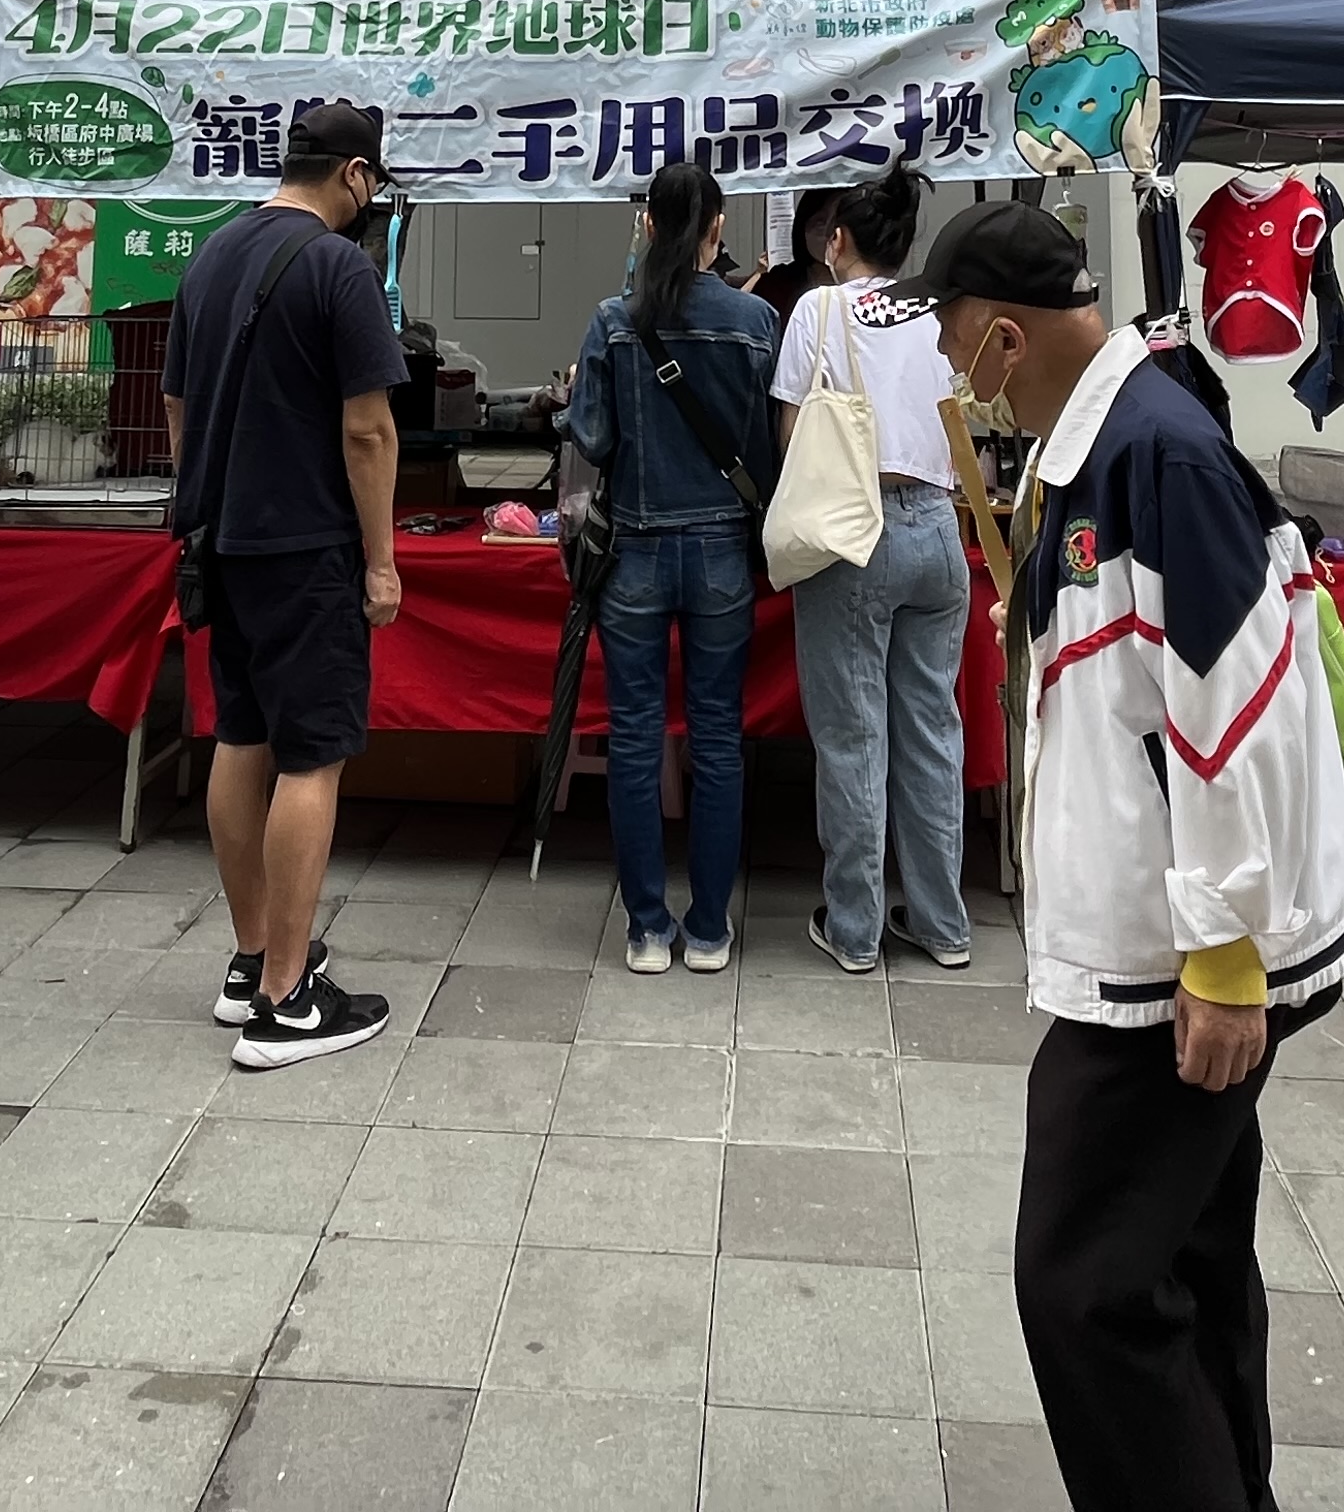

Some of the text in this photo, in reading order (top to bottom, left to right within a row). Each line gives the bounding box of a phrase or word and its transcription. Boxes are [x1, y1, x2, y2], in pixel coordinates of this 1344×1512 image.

[191, 82, 991, 183] 寵二手用品交換
[123, 228, 196, 258] 薩莉
